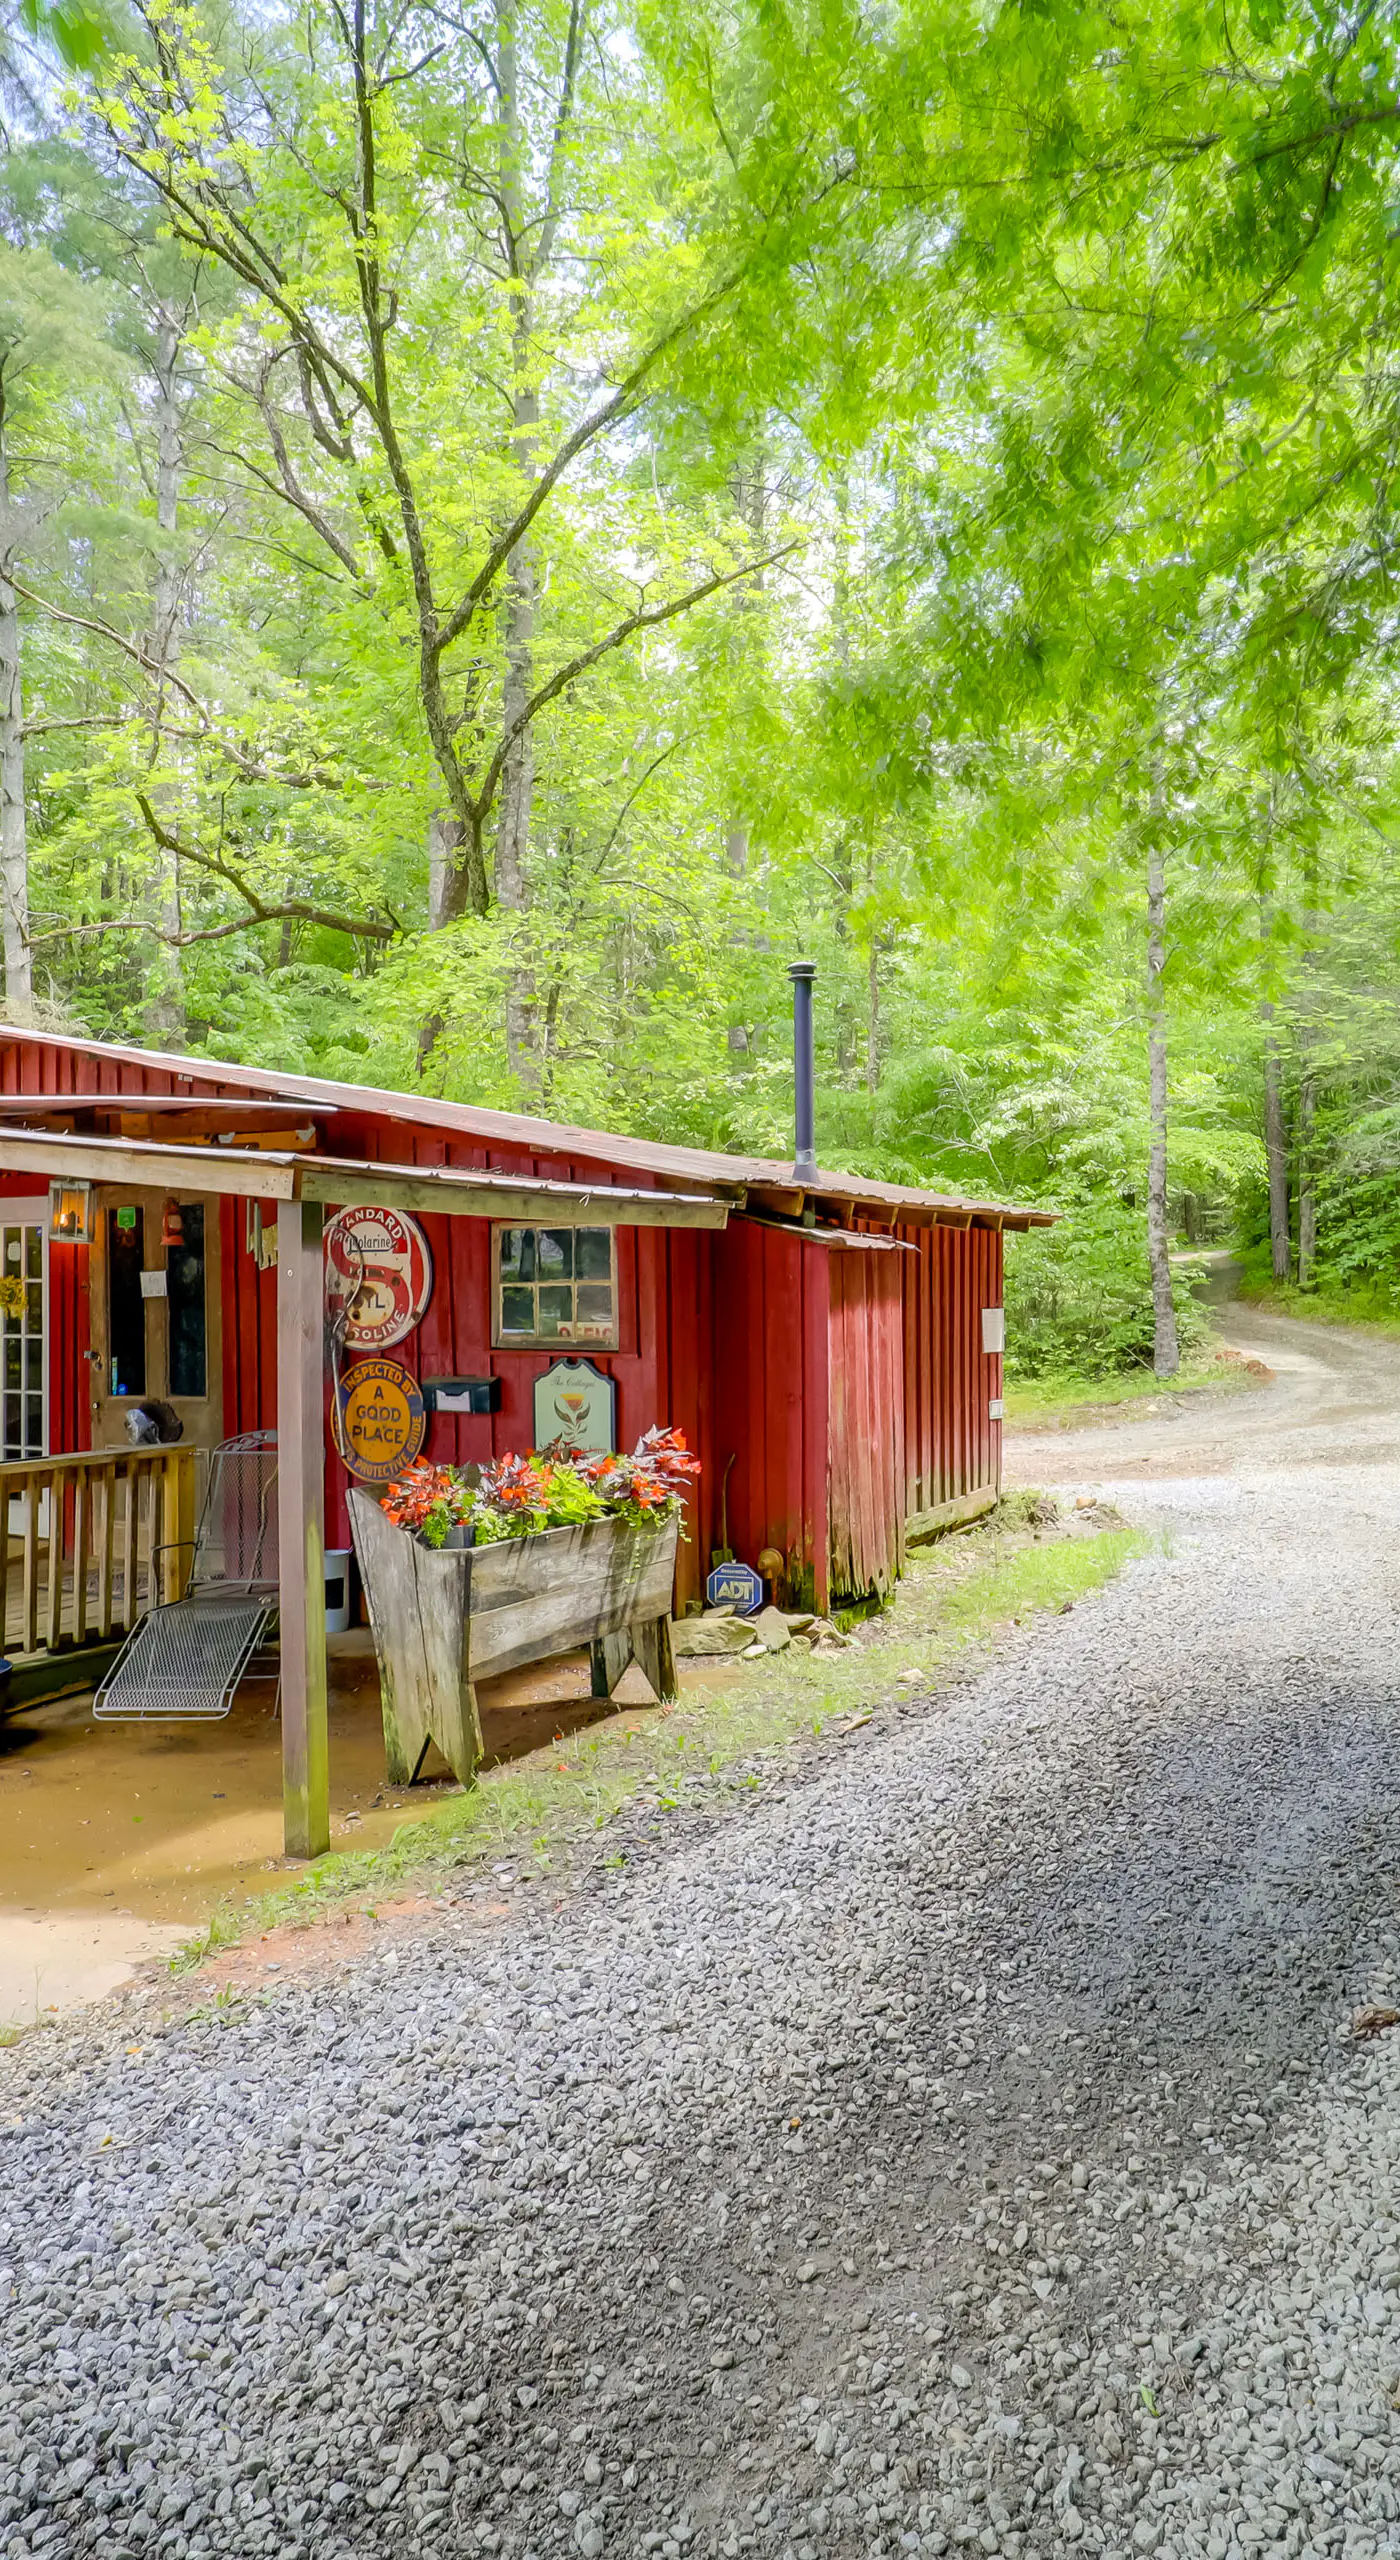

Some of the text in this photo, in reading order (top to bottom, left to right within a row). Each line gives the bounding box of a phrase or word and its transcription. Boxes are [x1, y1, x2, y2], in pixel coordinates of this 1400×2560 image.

[333, 1208, 403, 1242] SANDARD
[344, 1364, 417, 1397] INSPECTED BY
[373, 1386, 384, 1401] A
[356, 1405, 402, 1422] GOOD
[352, 1425, 404, 1444] PLACE
[354, 1415, 422, 1477] PROTECTIVE GUIDE
[718, 1581, 752, 1600] ADT
